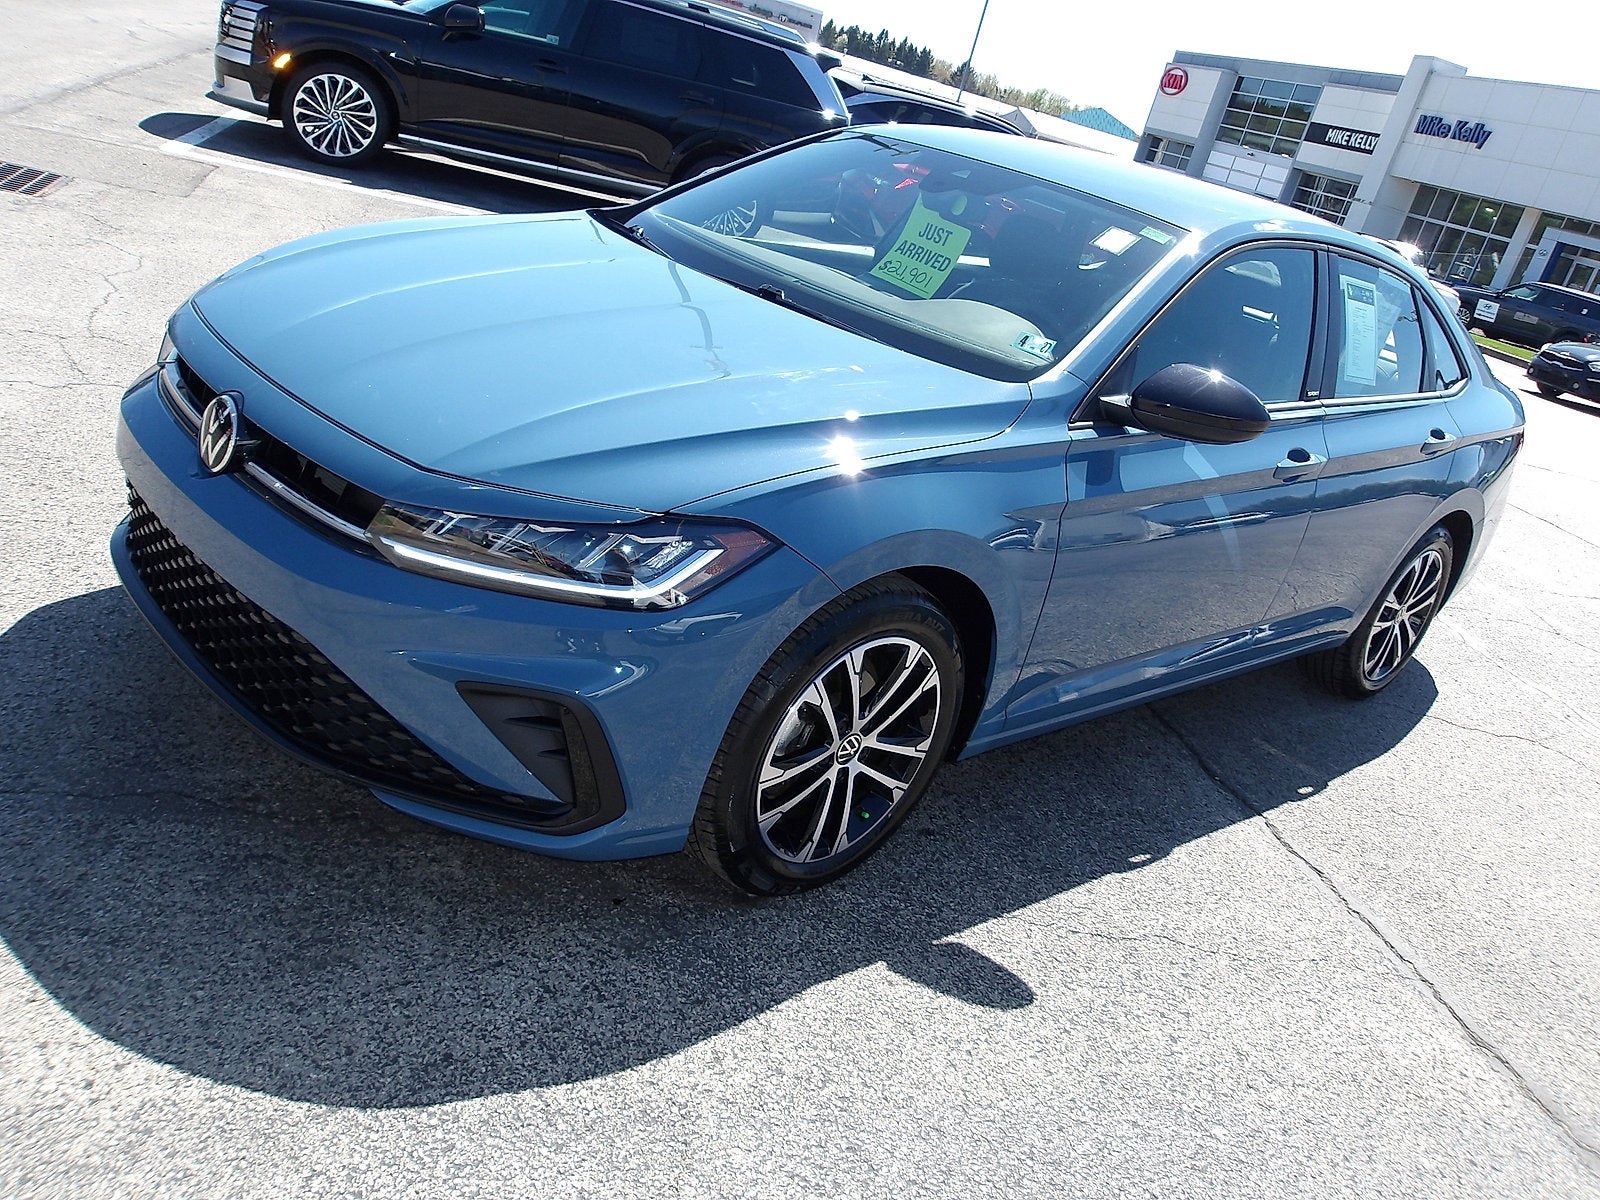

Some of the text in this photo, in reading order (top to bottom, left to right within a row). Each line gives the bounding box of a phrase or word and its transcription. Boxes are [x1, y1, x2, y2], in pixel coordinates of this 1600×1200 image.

[1163, 73, 1184, 90] KIA
[1325, 128, 1379, 151] MIKE KELLY
[1413, 114, 1493, 150] Mike Kelly
[918, 222, 954, 247] JUST
[894, 239, 952, 273] ARRIVED
[878, 259, 934, 288] $21,901
